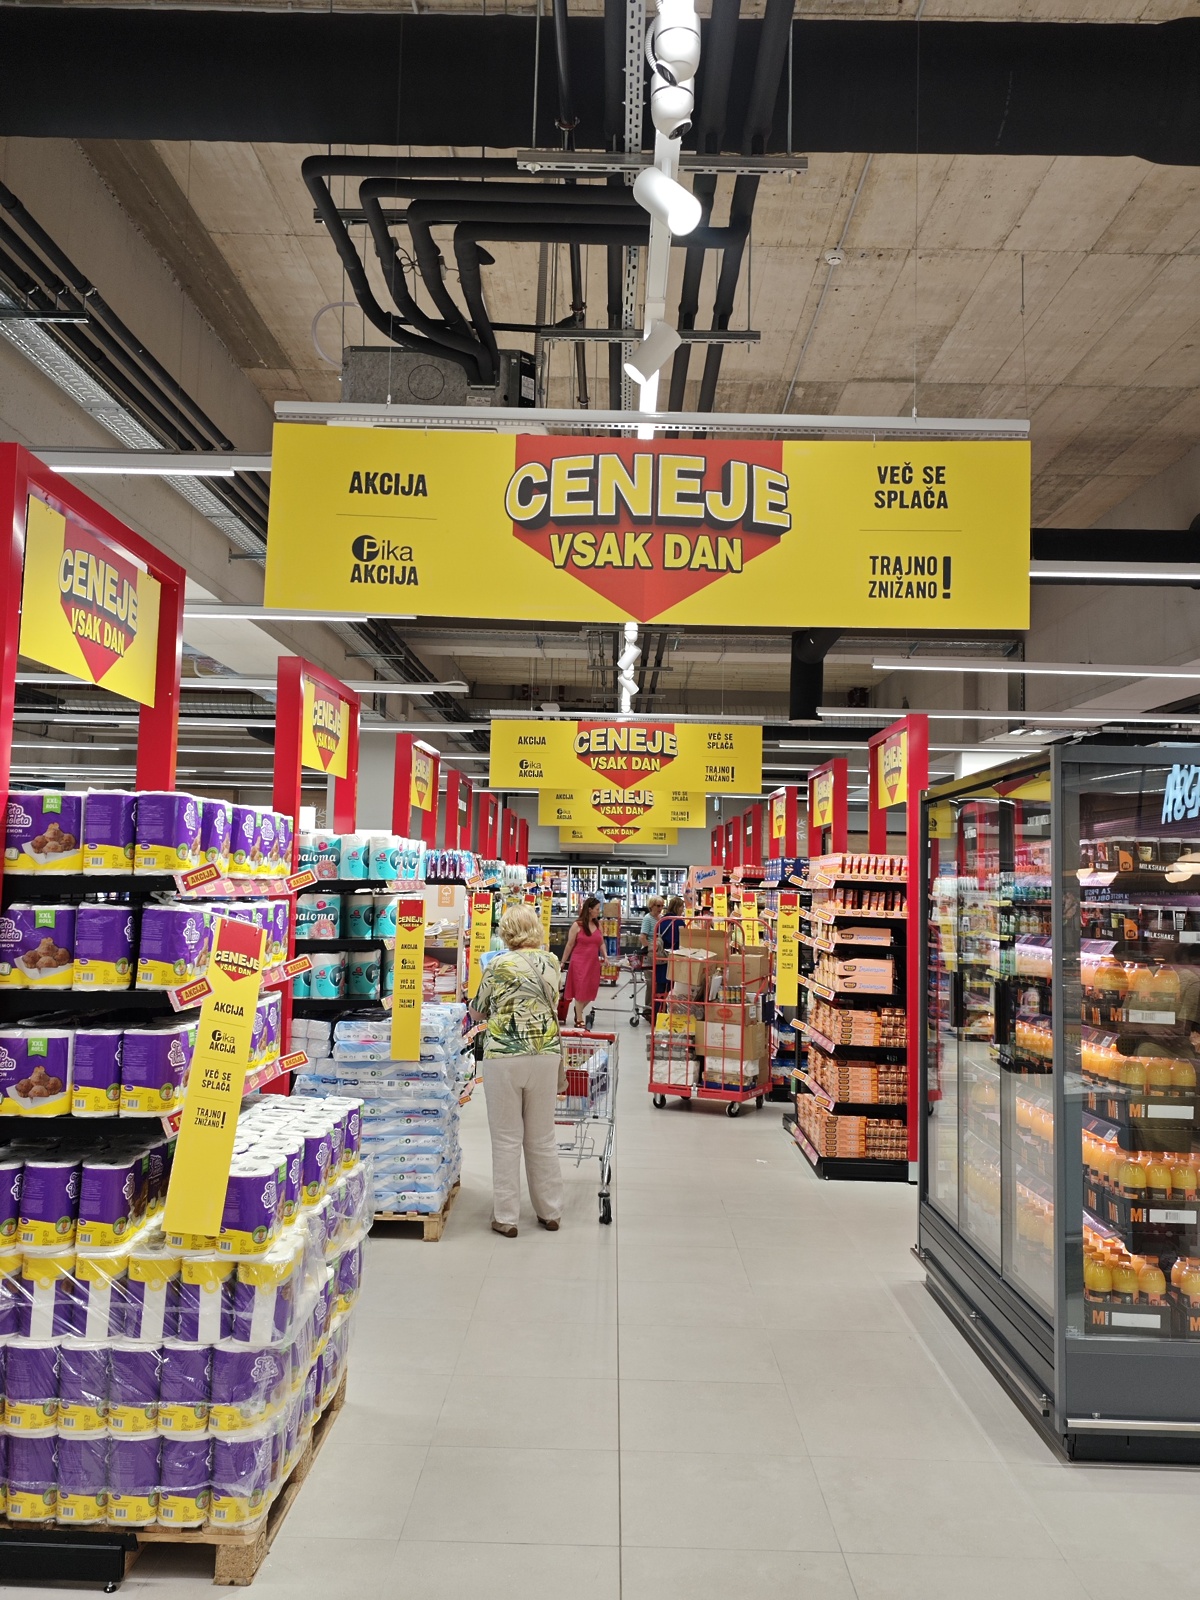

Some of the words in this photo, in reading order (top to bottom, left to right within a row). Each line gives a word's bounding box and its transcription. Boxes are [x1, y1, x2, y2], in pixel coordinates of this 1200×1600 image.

[877, 461, 913, 485] VEČ
[922, 466, 946, 485] SE
[349, 471, 428, 497] AKCIJA
[505, 453, 792, 536] CENEJE
[874, 486, 948, 509] SPLAČA
[352, 534, 413, 563] Pika
[550, 532, 653, 569] VSAK
[664, 533, 743, 573] DAN
[869, 555, 938, 576] TRAJNO
[350, 563, 418, 586] AKCIJA
[58, 548, 138, 638] CENEJE
[868, 576, 938, 599] ZNIŽANO
[71, 607, 101, 645] VSAK
[103, 621, 125, 657] DAN
[517, 736, 547, 746] AKCIJA
[574, 727, 678, 757] CENEJE
[708, 732, 721, 741] VEČ
[724, 733, 733, 741] SE
[707, 740, 734, 750] SPLAČA
[590, 756, 627, 770] VSAK
[631, 758, 661, 772] DAN
[705, 766, 730, 775] TRAJNO
[518, 769, 544, 778] AKCIJA
[705, 774, 730, 783] ZNIŽANO
[590, 789, 655, 808] CENEJE
[600, 806, 624, 816] VSAK
[625, 807, 645, 817] DAN
[190, 869, 215, 882] AKCIJA
[1143, 930, 1175, 941] MILKSHAKE
[214, 950, 260, 971] CENEJE
[219, 964, 237, 973] VSAK
[238, 967, 252, 977] DAN
[184, 984, 207, 999] AKCIJA
[213, 1001, 244, 1017] AKCIJA
[211, 1029, 236, 1044] Pika
[208, 1041, 236, 1055] AKCIJA
[286, 1055, 304, 1068] AKCIJA
[205, 1068, 219, 1080] VEČ
[221, 1072, 232, 1082] SE
[201, 1079, 231, 1093] SPLAČA
[197, 1107, 222, 1120] TRAJNO
